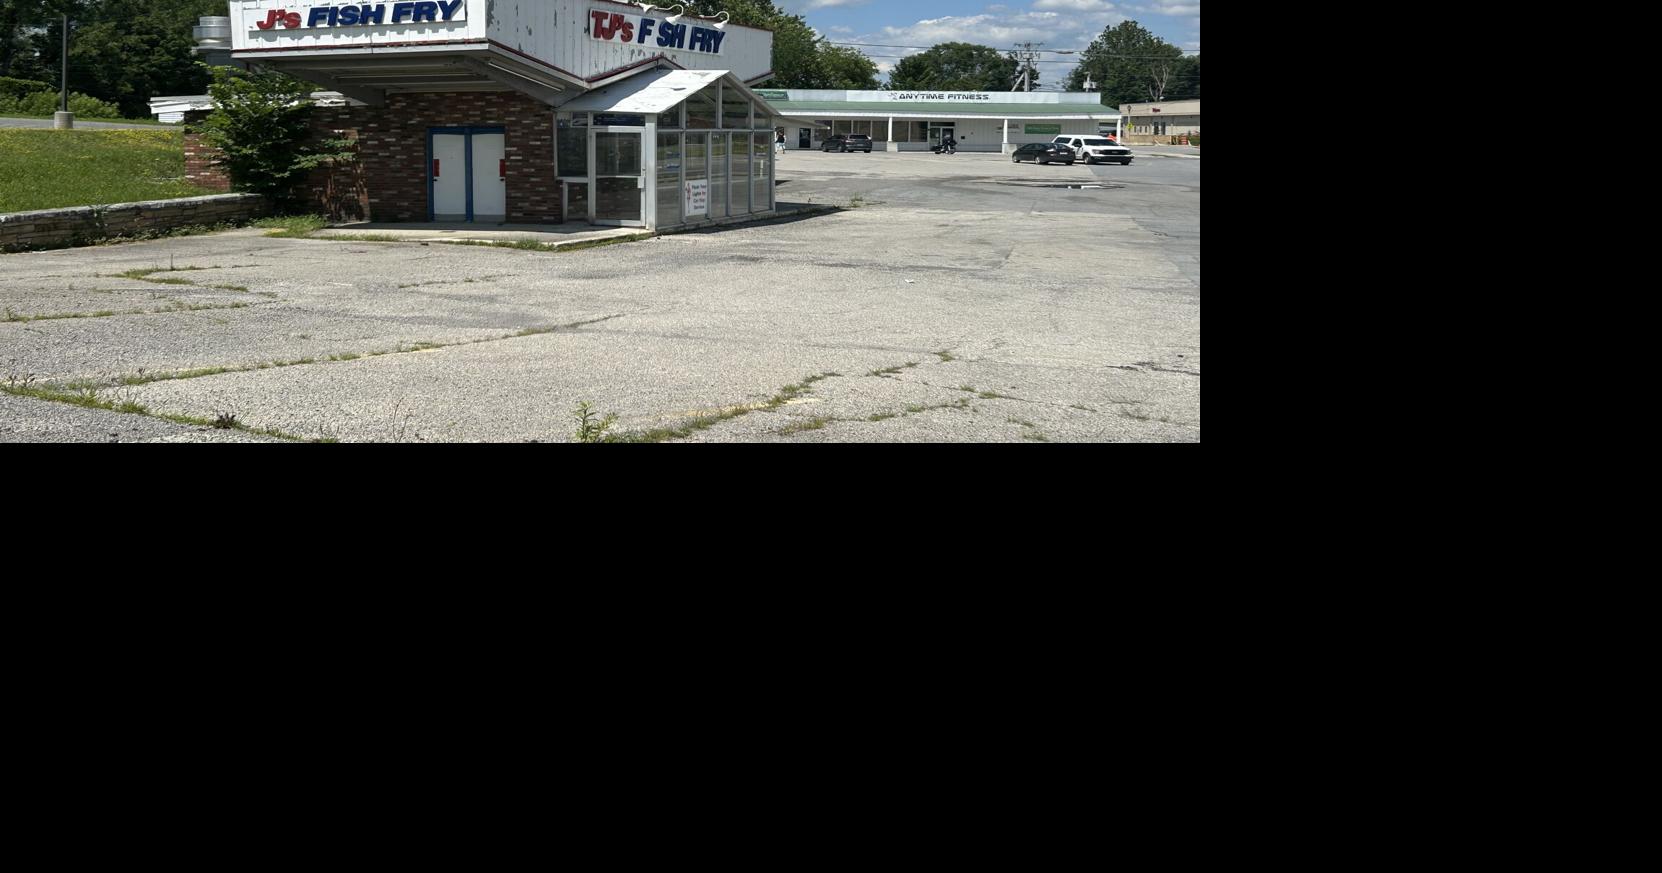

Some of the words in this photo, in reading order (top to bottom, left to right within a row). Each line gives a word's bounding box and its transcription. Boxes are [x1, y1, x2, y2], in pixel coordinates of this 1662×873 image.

[256, 9, 302, 30] J's
[307, 3, 385, 27] FISH
[392, 0, 465, 23] FRY
[591, 10, 634, 42] TJ's
[689, 27, 726, 54] FRY
